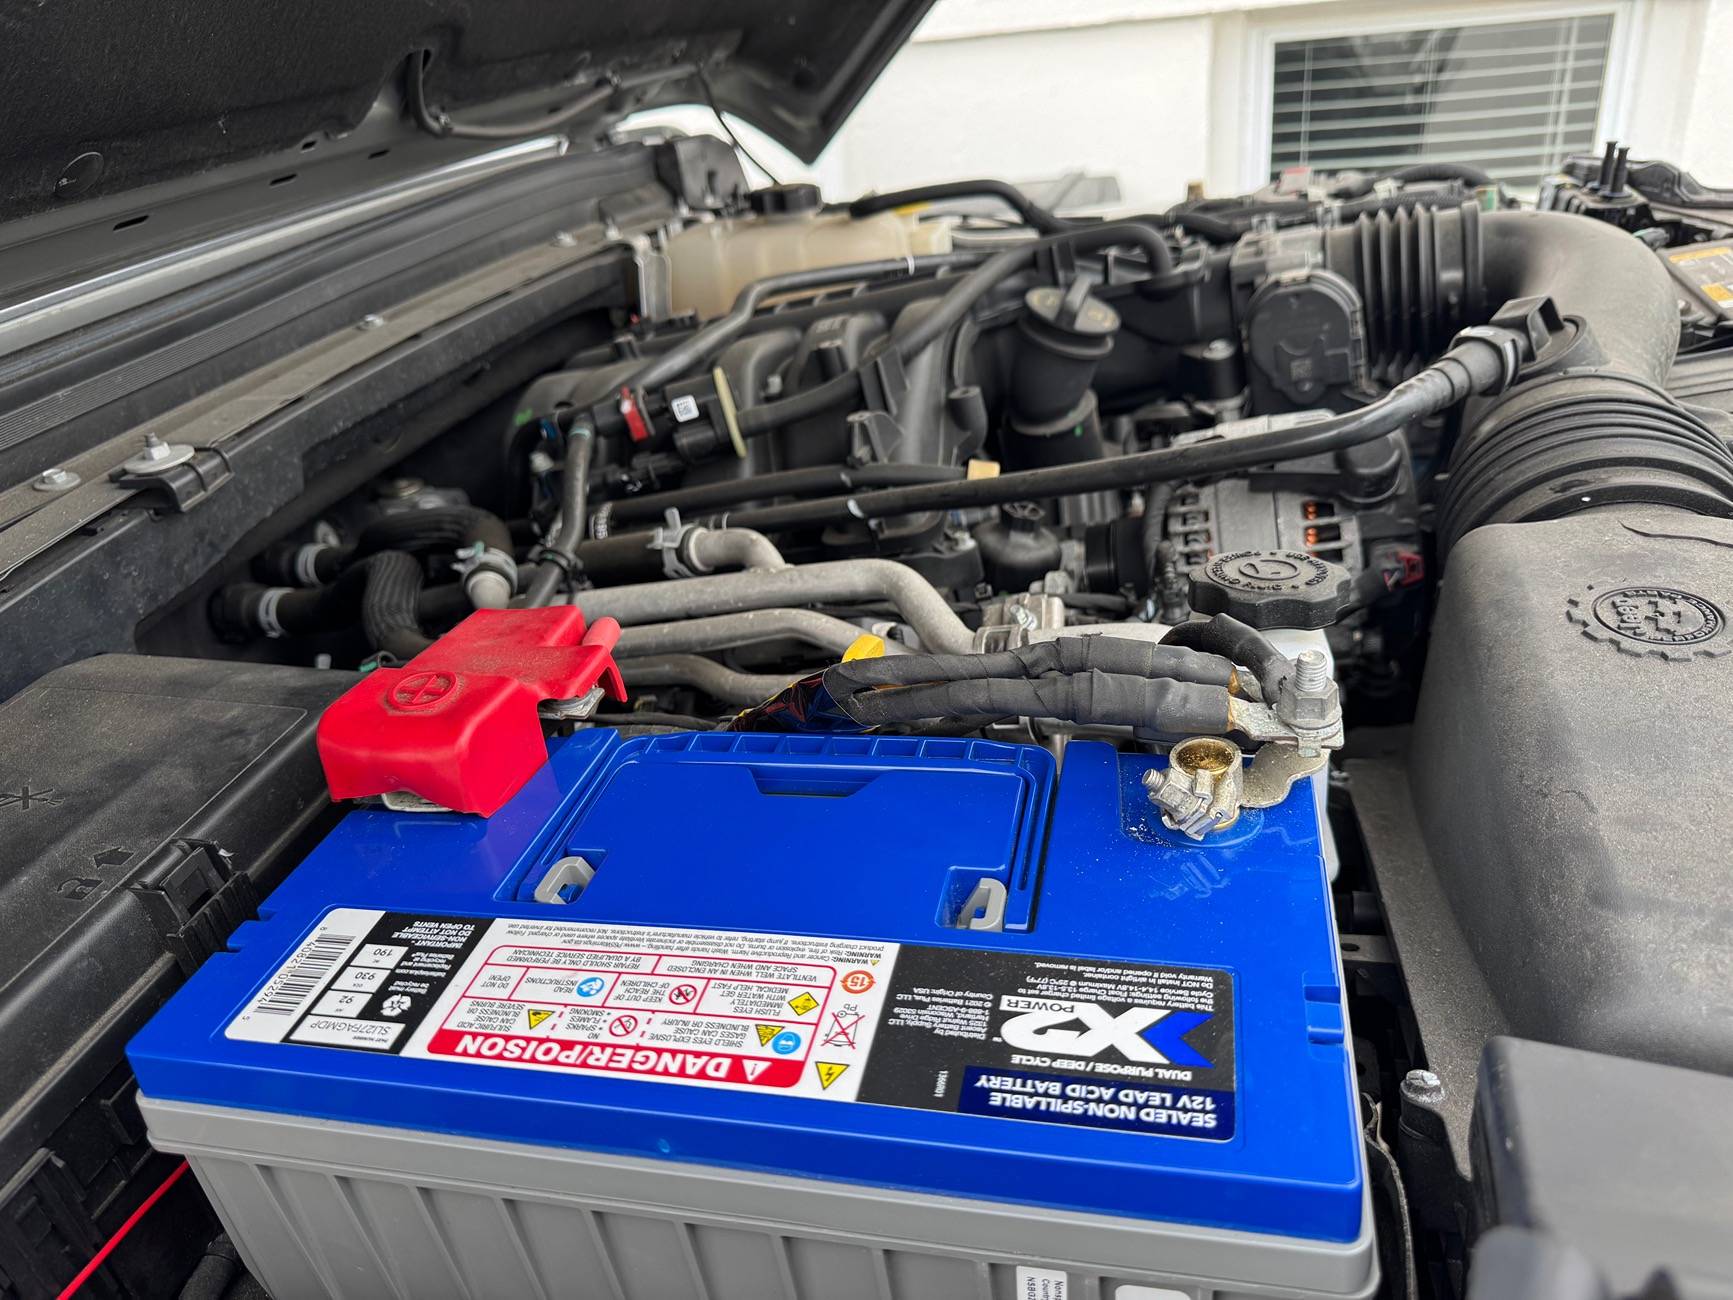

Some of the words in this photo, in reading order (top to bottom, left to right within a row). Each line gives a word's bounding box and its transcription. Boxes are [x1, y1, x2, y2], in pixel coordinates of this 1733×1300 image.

[1612, 597, 1647, 636] Jeep
[391, 931, 467, 941] NON-SERVICEABLE
[414, 940, 463, 948] IMPORTANT
[512, 948, 555, 956] TECHNICIAN
[690, 959, 730, 967] CHARGING
[666, 965, 706, 973] ENCLOSED
[353, 971, 377, 980] 930
[775, 973, 817, 981] VENTILATE
[1120, 974, 1146, 982] airtight
[524, 977, 578, 985] INSTRUCTIONS
[848, 975, 867, 987] 15
[257, 973, 289, 1004] 05294
[754, 985, 788, 993] MEDICAL
[930, 988, 954, 996] Origin:
[1040, 989, 1069, 997] charger
[337, 994, 355, 1003] 92
[733, 991, 764, 999] WATER
[964, 991, 993, 999] Country
[1097, 994, 1125, 1002] voltage
[729, 998, 783, 1008] IMMEDIATELY
[1005, 998, 1074, 1013] POWER
[1134, 997, 1165, 1006] requires
[1166, 1000, 1194, 1009] battery
[478, 1008, 521, 1016] BLINDNESS
[568, 1008, 605, 1016] SMOKING
[917, 1009, 954, 1017] Wisconsin
[955, 1012, 989, 1020] Hartland,
[568, 1015, 601, 1023] FLAMES
[661, 1018, 690, 1026] INJURY
[904, 1018, 932, 1027] Supply,
[918, 1014, 941, 1022] Ridge
[473, 1023, 512, 1031] SULFURIC
[564, 1022, 597, 1030] SPARKS
[703, 1021, 750, 1031] BLINDNESS
[932, 1021, 959, 1030] Battery
[673, 1027, 702, 1035] CAUSE
[719, 1031, 746, 1039] GASES
[944, 1029, 985, 1039] Distributed
[647, 1033, 691, 1042] EXPLOSIVE
[713, 1039, 743, 1047] SHIELD
[452, 1034, 733, 1077] DANGER/POISON
[1009, 1054, 1050, 1066] CYCLE
[1049, 1058, 1085, 1070] DEEP
[1093, 1062, 1153, 1077] PURPOSE
[1154, 1067, 1192, 1081] DUAL
[973, 1074, 1061, 1095] BATTERY
[1064, 1082, 1115, 1100] ACID
[1117, 1088, 1172, 1106] LEAD
[1176, 1093, 1215, 1110] 12V
[987, 1091, 1136, 1119] NON-SPILLABLE
[1139, 1106, 1217, 1128] SEALED
